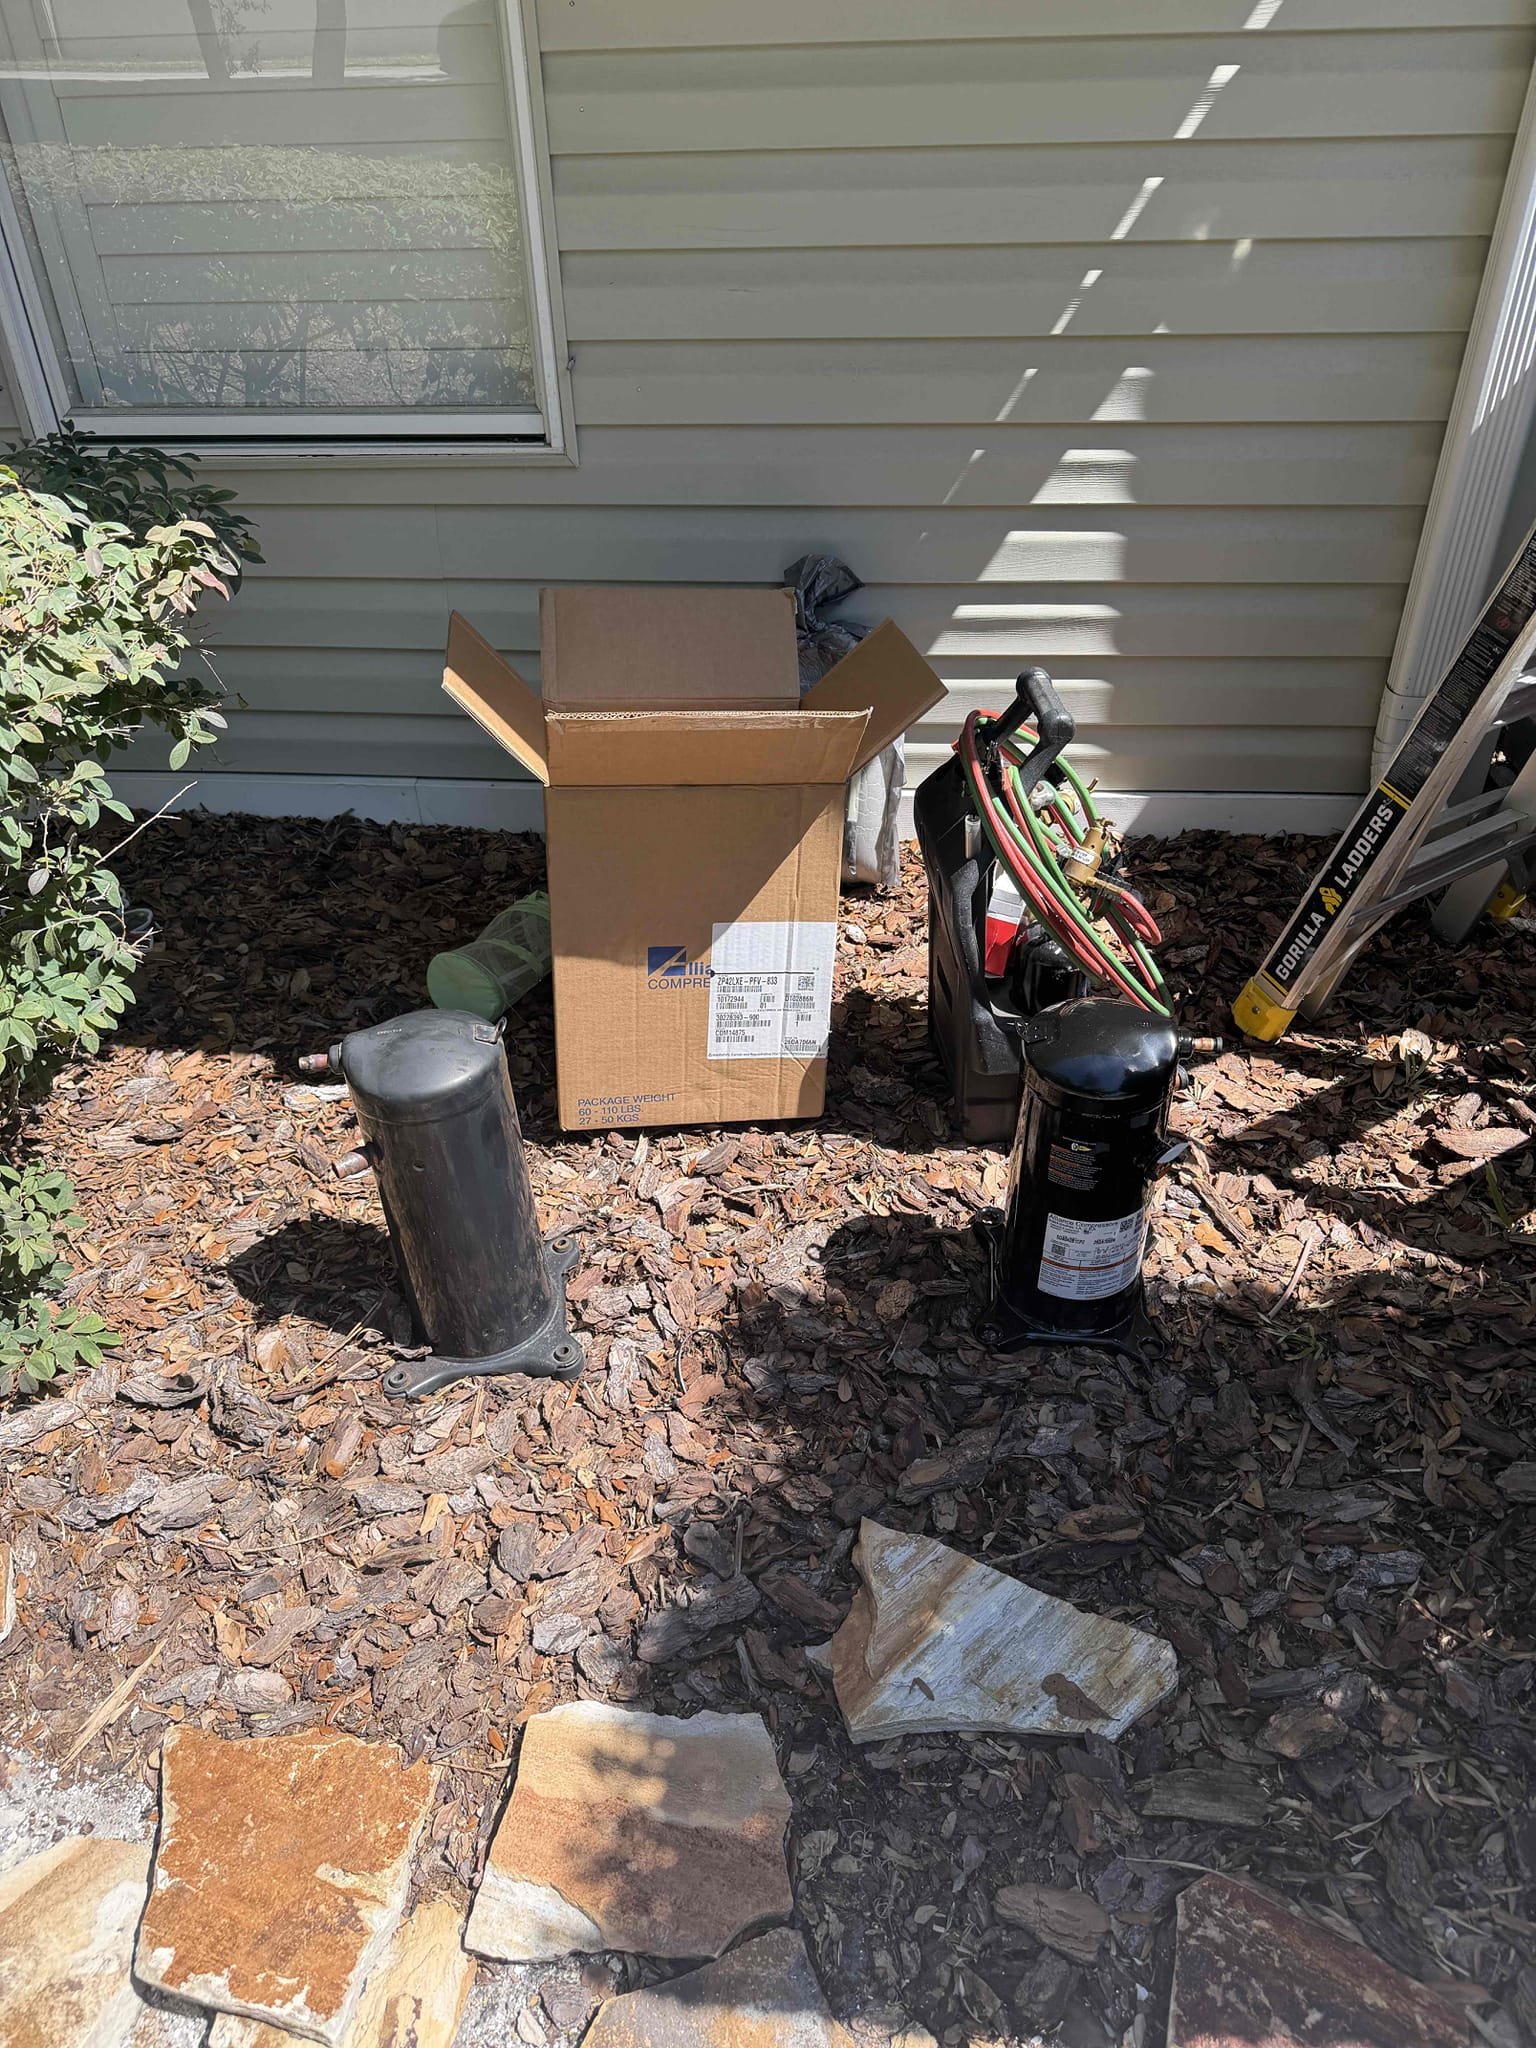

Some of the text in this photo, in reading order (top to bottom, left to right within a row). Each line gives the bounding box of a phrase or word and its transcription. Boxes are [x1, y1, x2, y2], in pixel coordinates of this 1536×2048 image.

[1275, 804, 1394, 981] GORILLA LADDERS
[577, 1092, 676, 1107] PACKAGE WEIGHT
[578, 1107, 592, 1117] 60
[602, 1105, 618, 1115] 110
[579, 1116, 592, 1126] 27
[601, 1115, 614, 1125] 50
